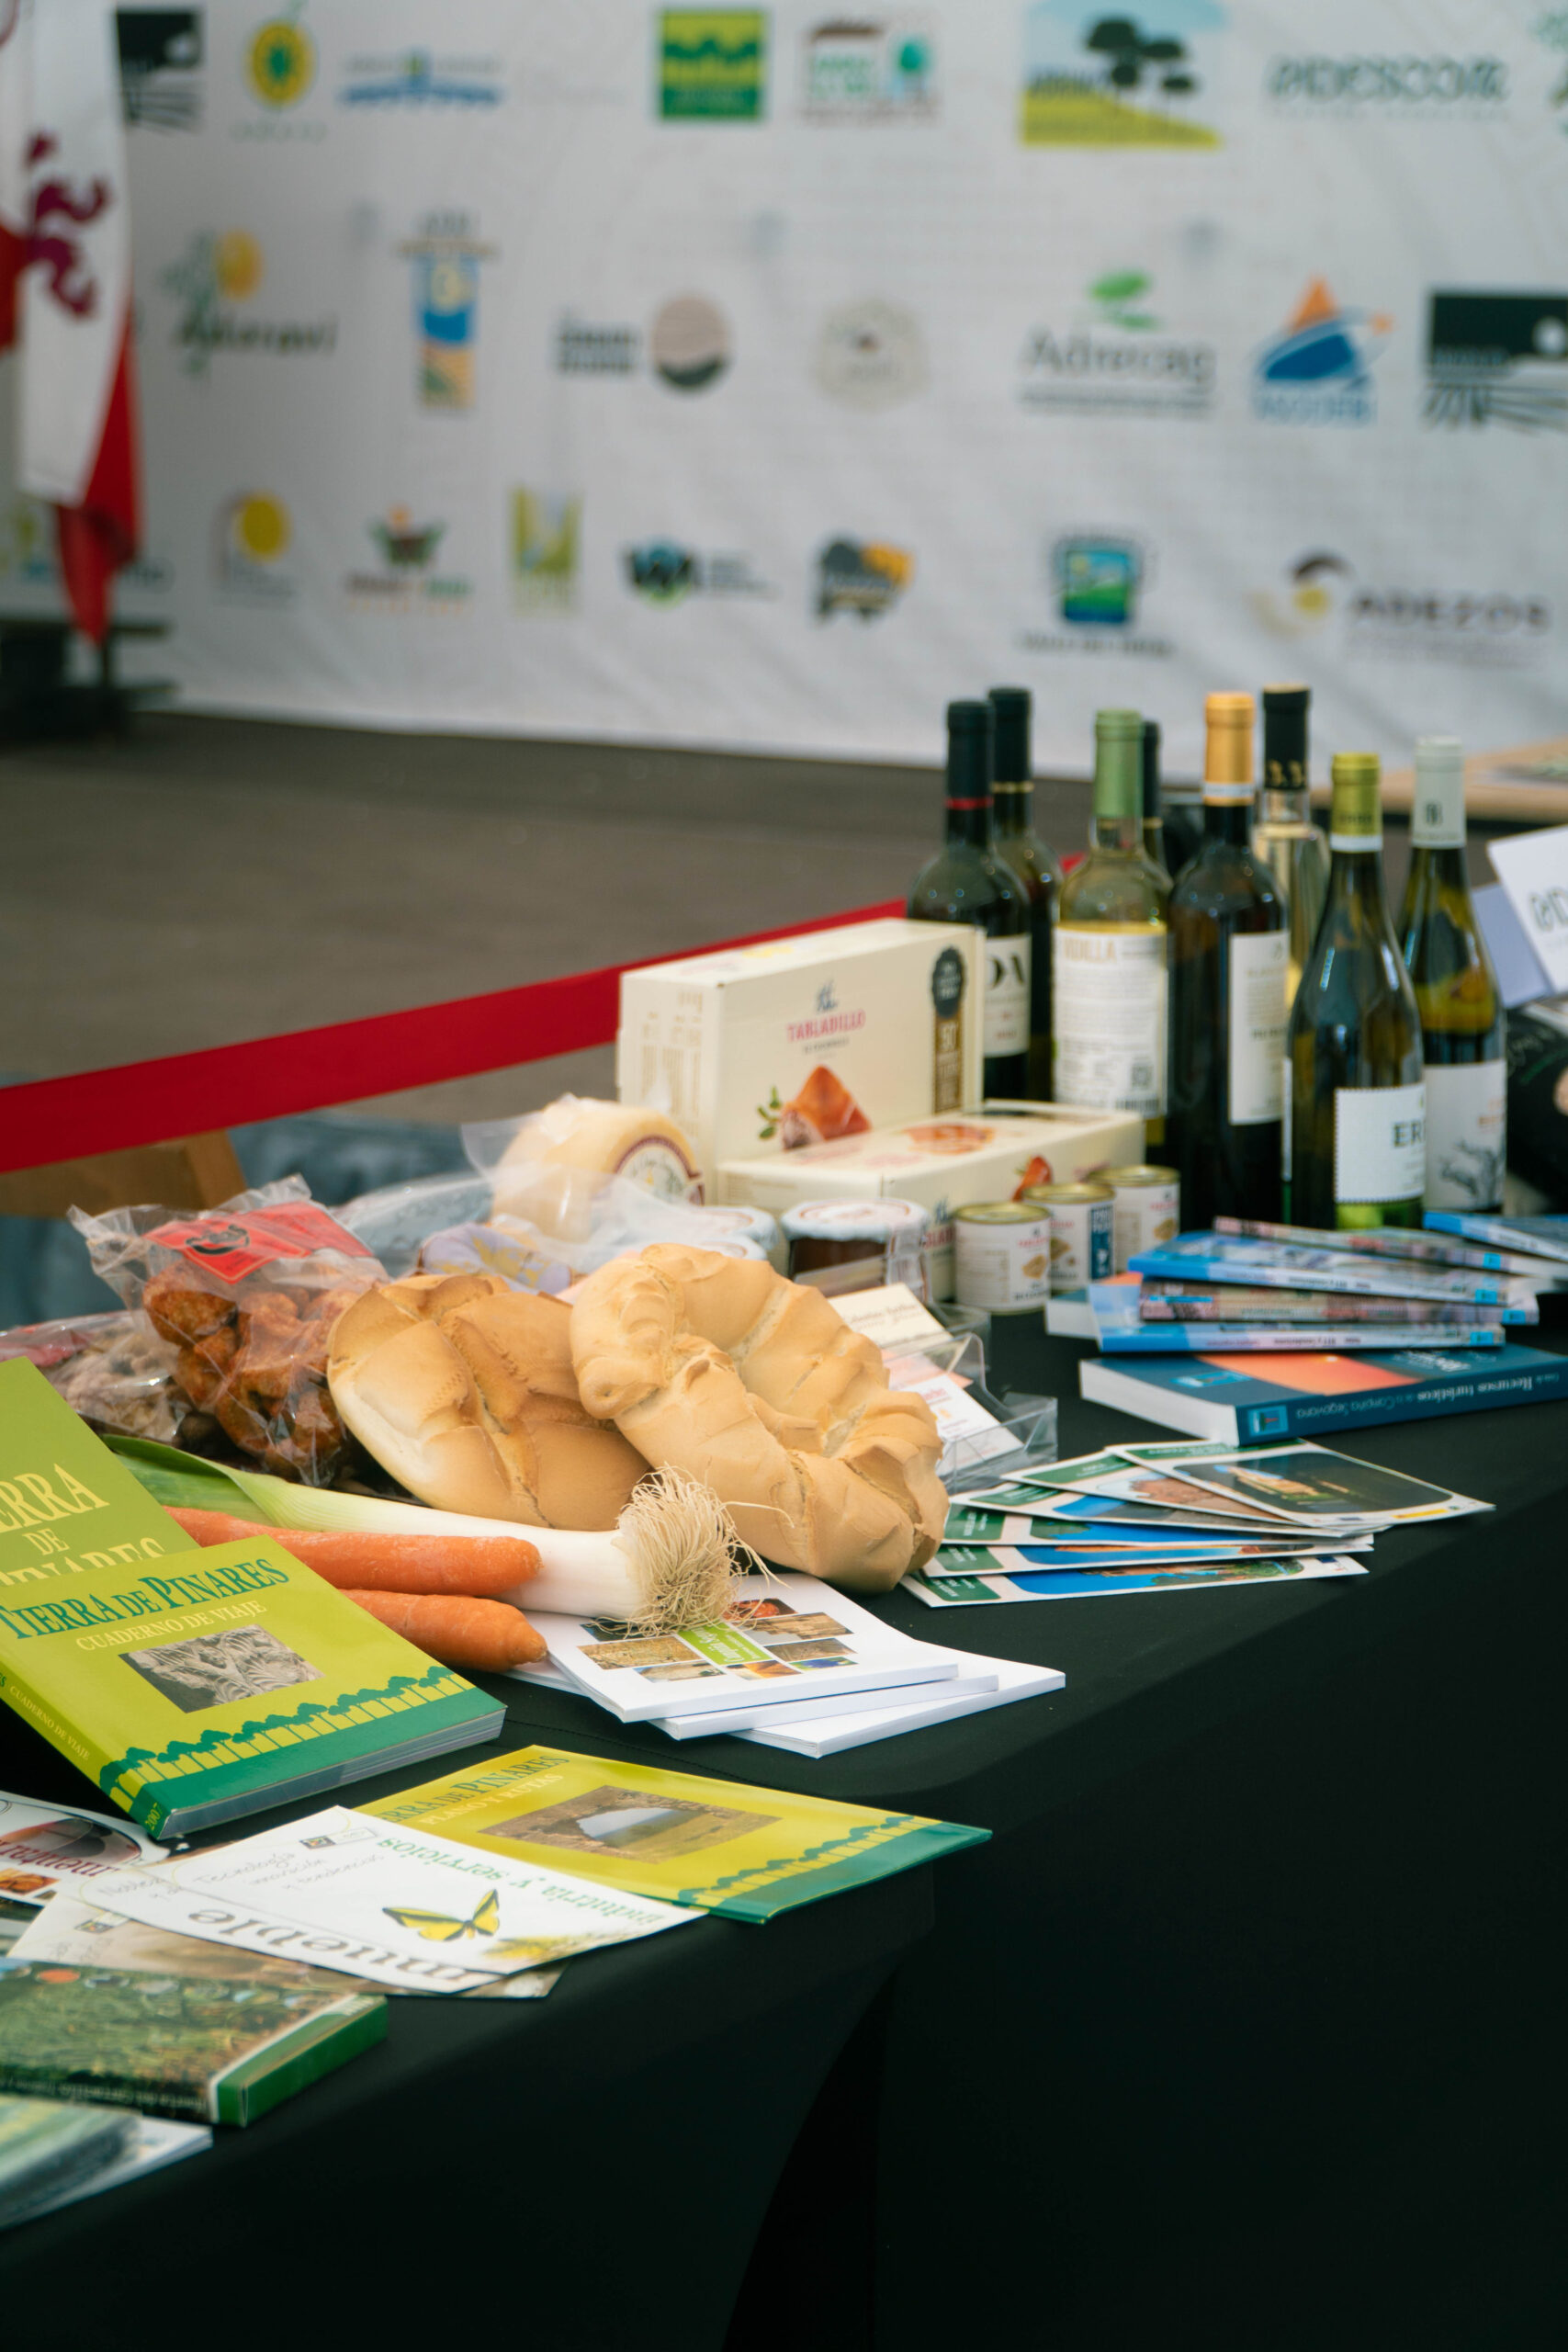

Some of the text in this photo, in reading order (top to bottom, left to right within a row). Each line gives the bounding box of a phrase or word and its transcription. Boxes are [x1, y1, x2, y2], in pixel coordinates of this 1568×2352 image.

[786, 1009, 866, 1042] TABLADILLO
[1477, 1376, 1534, 1392] Recursos
[22, 1528, 70, 1555] DE
[110, 1589, 164, 1618] DE
[138, 1558, 290, 1610] PINARES
[75, 1600, 268, 1651] CUADERNO DE VIAJE
[9, 1685, 55, 1728] CUADERNO
[53, 1724, 68, 1740] DE
[67, 1736, 91, 1760] VIAJE
[450, 1755, 570, 1792] PINARES
[144, 1803, 164, 1831] 2007
[419, 1801, 489, 1825] PLANO
[499, 1773, 564, 1798] RUTAS
[376, 1837, 503, 1881] servicios
[187, 1908, 469, 1980] mueble
